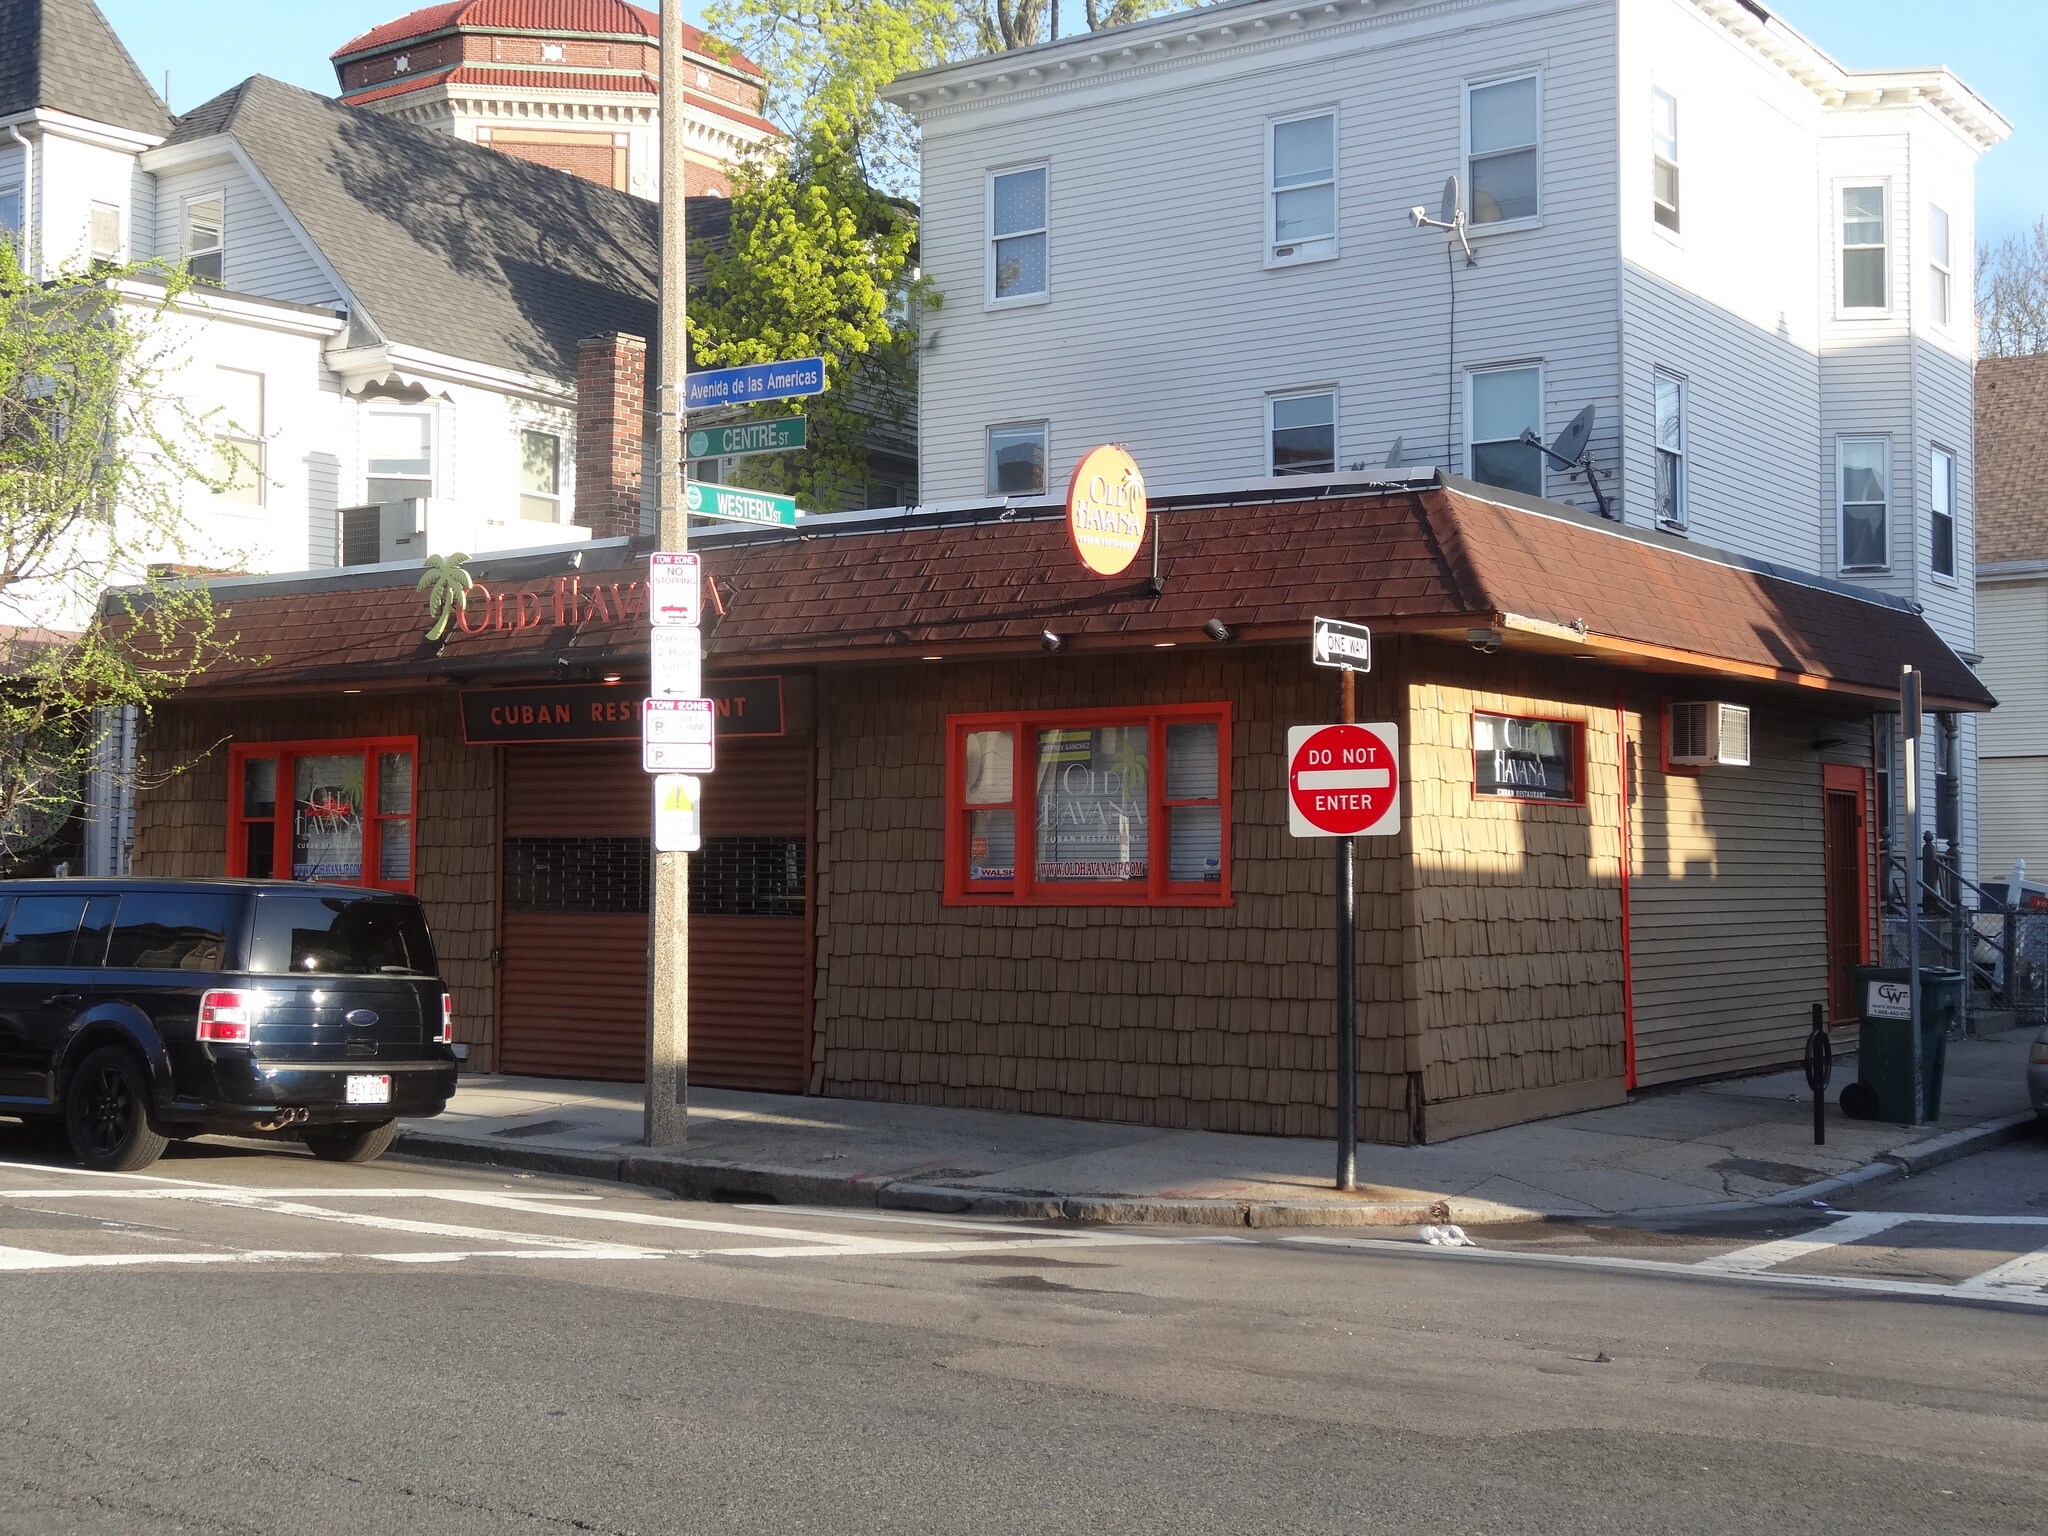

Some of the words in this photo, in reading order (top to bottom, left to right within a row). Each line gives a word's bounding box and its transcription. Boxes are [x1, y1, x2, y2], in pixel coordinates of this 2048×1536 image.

[690, 380, 729, 401] Avenida
[732, 378, 744, 394] de
[748, 375, 763, 393] las
[767, 369, 818, 390] Americas
[722, 423, 778, 452] CENTRE
[778, 431, 790, 446] ST
[1089, 474, 1128, 509] OLD
[716, 492, 775, 523] WESTERLY
[773, 510, 782, 524] ST
[1076, 500, 1140, 536] HAVANA
[655, 555, 673, 564] TOW
[674, 555, 695, 565] ZONE
[667, 567, 684, 576] NO
[655, 577, 696, 585] STOPPING
[456, 583, 542, 634] OLD
[552, 575, 726, 627] HAVAA
[1328, 635, 1346, 652] ONE
[1350, 637, 1365, 655] WAY
[490, 703, 571, 725] CUBAN
[591, 697, 746, 722] RESTNT
[650, 700, 675, 710] TOW
[678, 701, 709, 711] ZONE
[1503, 717, 1533, 753] OLD
[1309, 749, 1332, 765] DO
[1343, 747, 1377, 764] NOT
[1494, 749, 1547, 787] HAVANA
[1063, 763, 1122, 796] OLD
[310, 783, 349, 812] OLD
[1040, 793, 1144, 826] HAVANA
[1315, 794, 1372, 811] ENTER
[295, 809, 362, 836] HAVANA
[1044, 834, 1076, 844] CUBAN
[1080, 834, 1140, 843] RESTAURNT
[1040, 860, 1144, 878] WWW.OLDHAVANAJP.COM
[1874, 1009, 1911, 1017] 1-866-443-670
